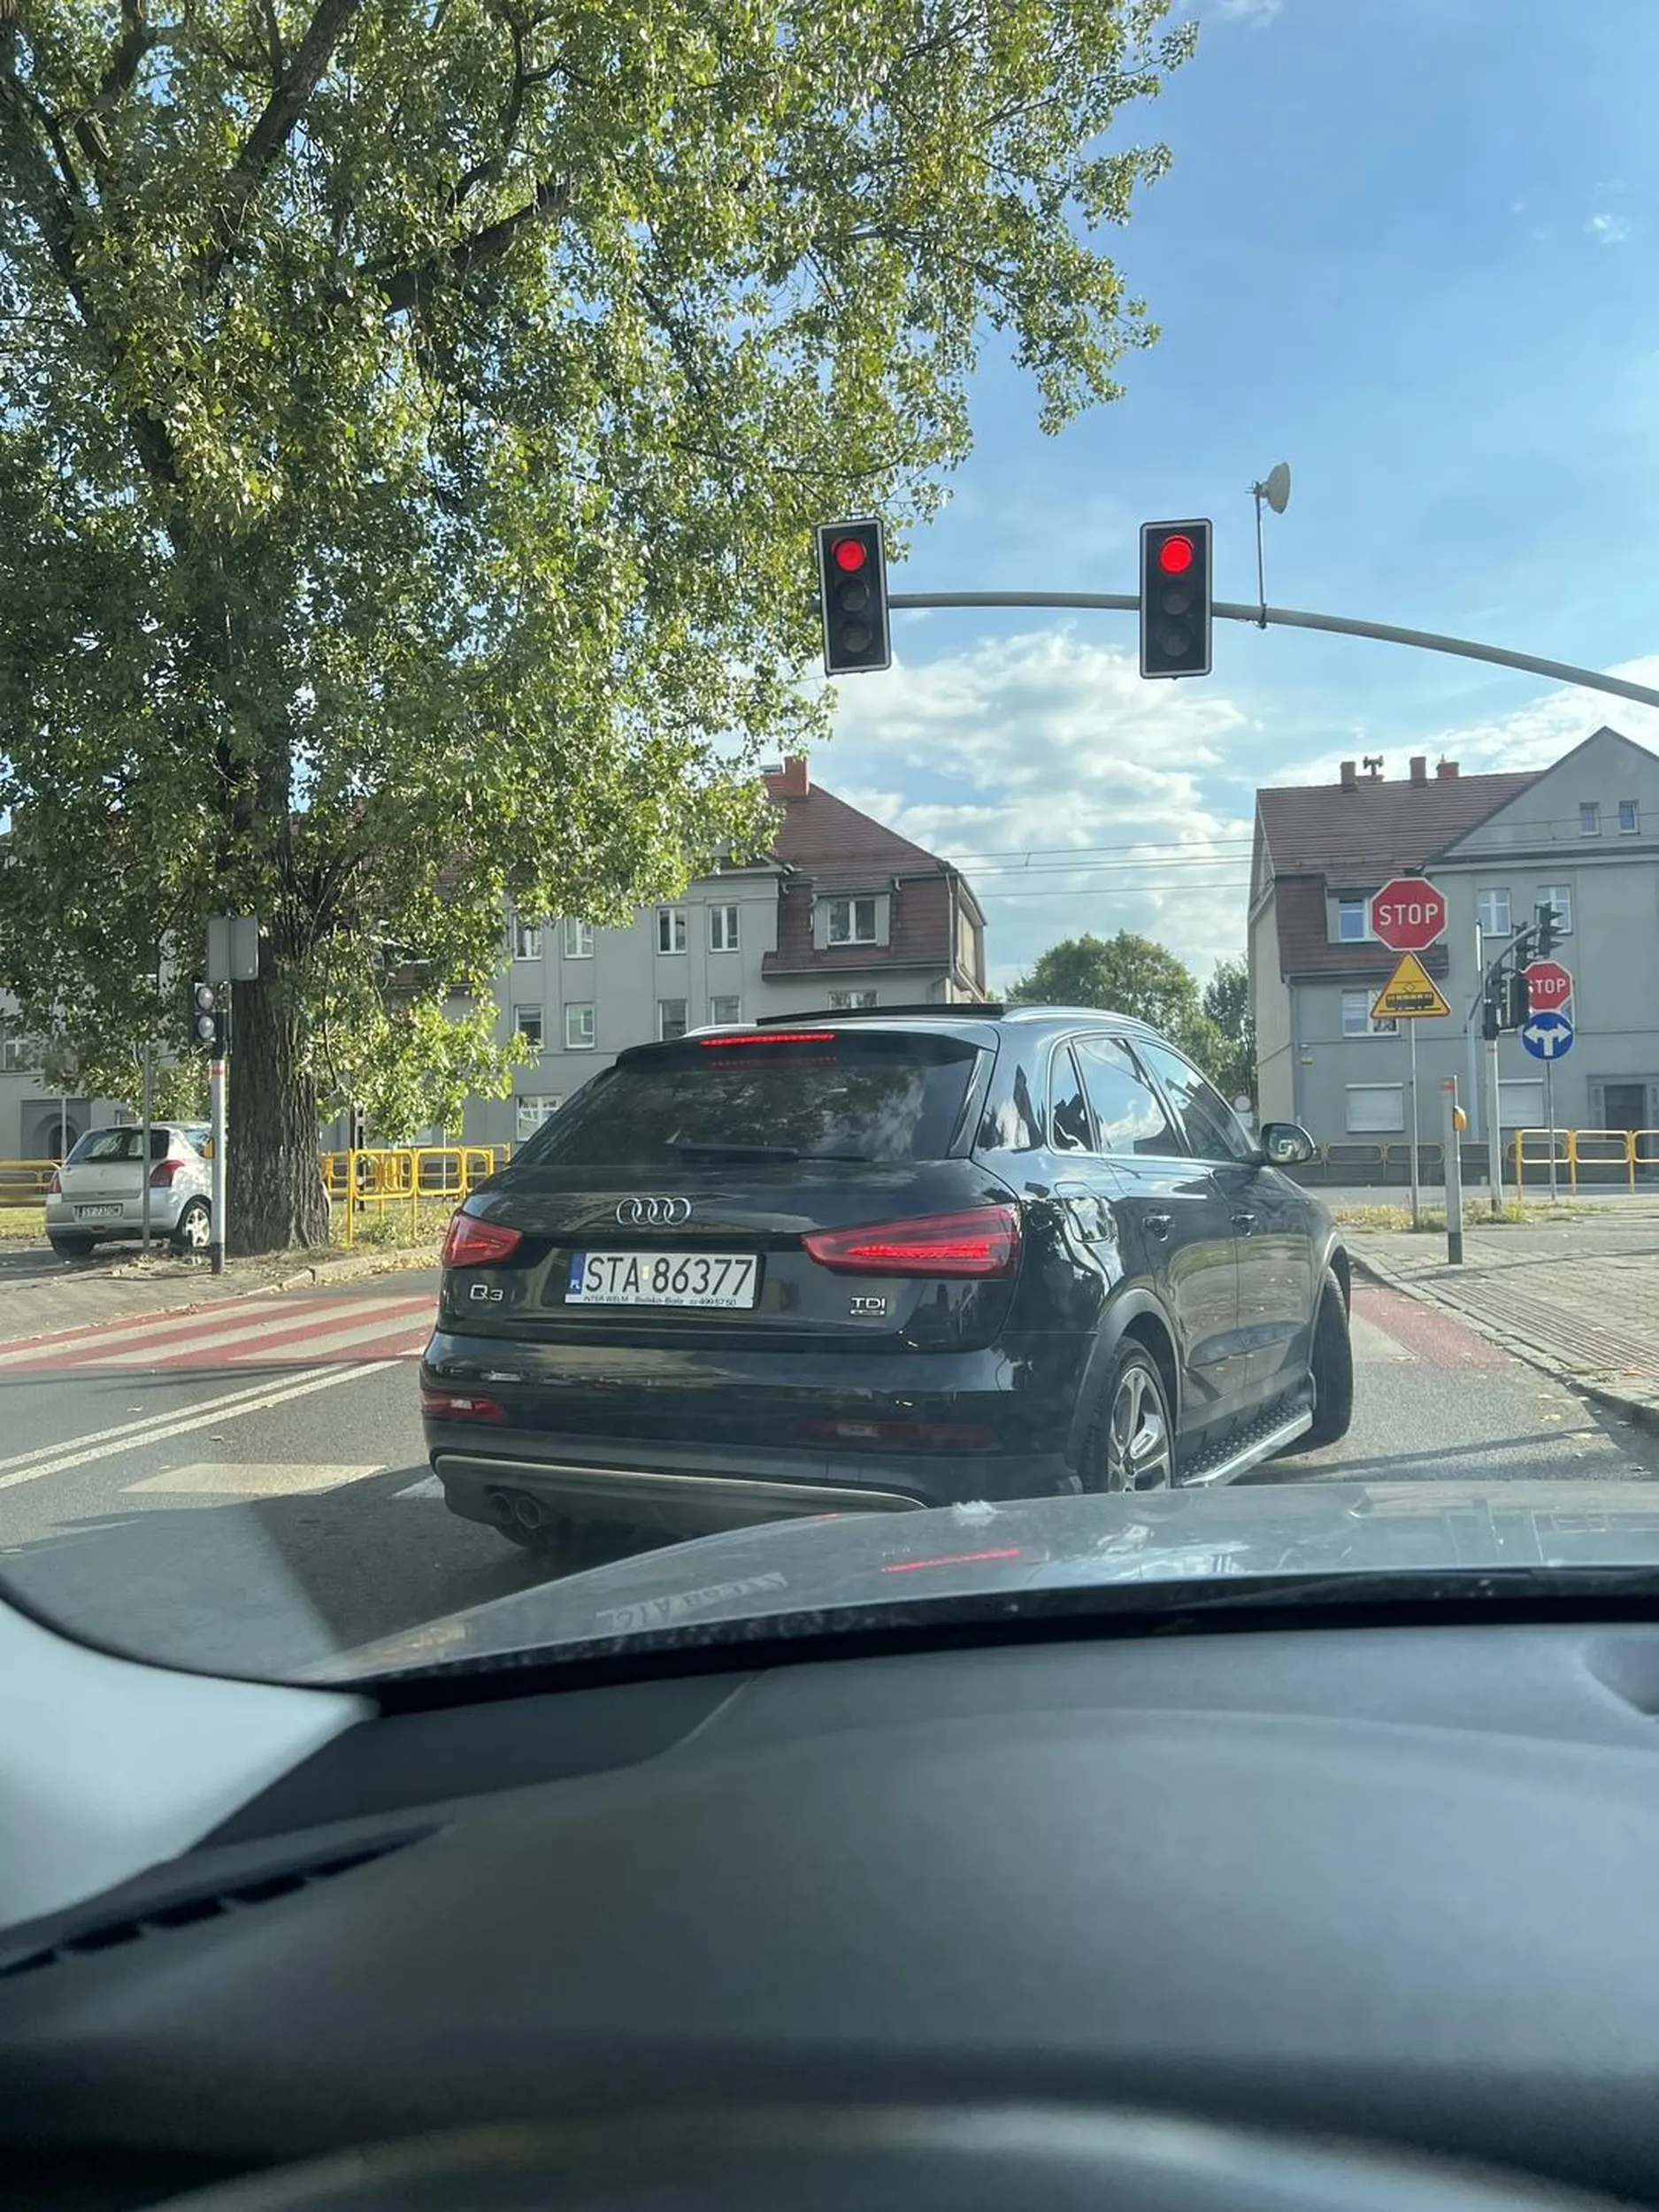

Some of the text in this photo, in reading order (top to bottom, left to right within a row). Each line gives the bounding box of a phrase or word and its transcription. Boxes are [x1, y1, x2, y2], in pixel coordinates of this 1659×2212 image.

[1379, 902, 1439, 926] STOP
[586, 1256, 753, 1295] STA 86377
[470, 1284, 503, 1301] Q3
[850, 1297, 886, 1310] TDI
